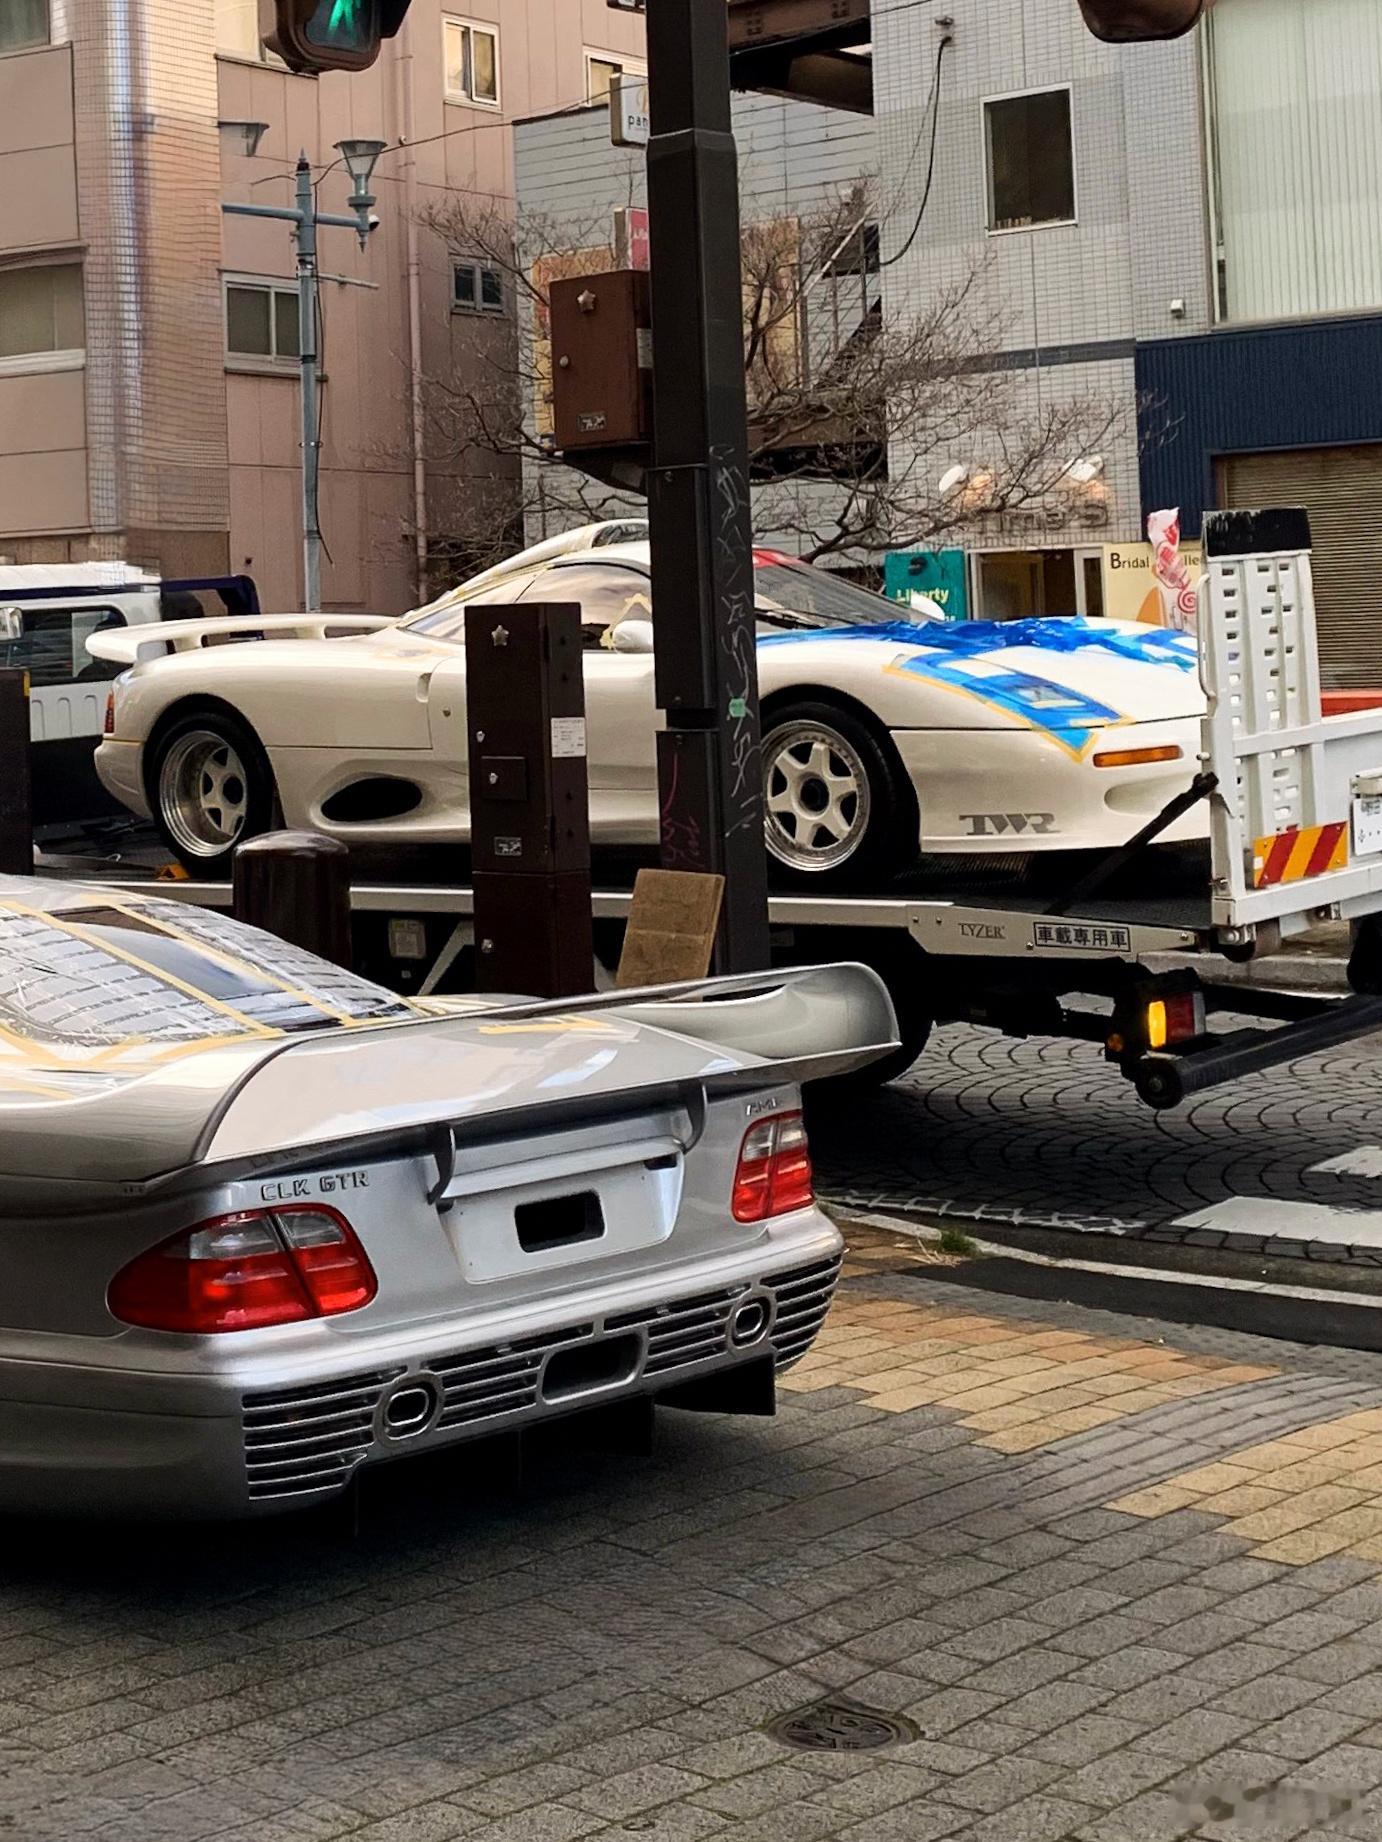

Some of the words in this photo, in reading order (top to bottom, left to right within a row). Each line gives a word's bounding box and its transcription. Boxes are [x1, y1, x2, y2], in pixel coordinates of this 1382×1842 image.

[1110, 552, 1149, 569] Bridal
[896, 588, 949, 604] Lirty
[959, 813, 1061, 835] TWR
[261, 1179, 310, 1201] CLK
[319, 1170, 369, 1193] GTR
